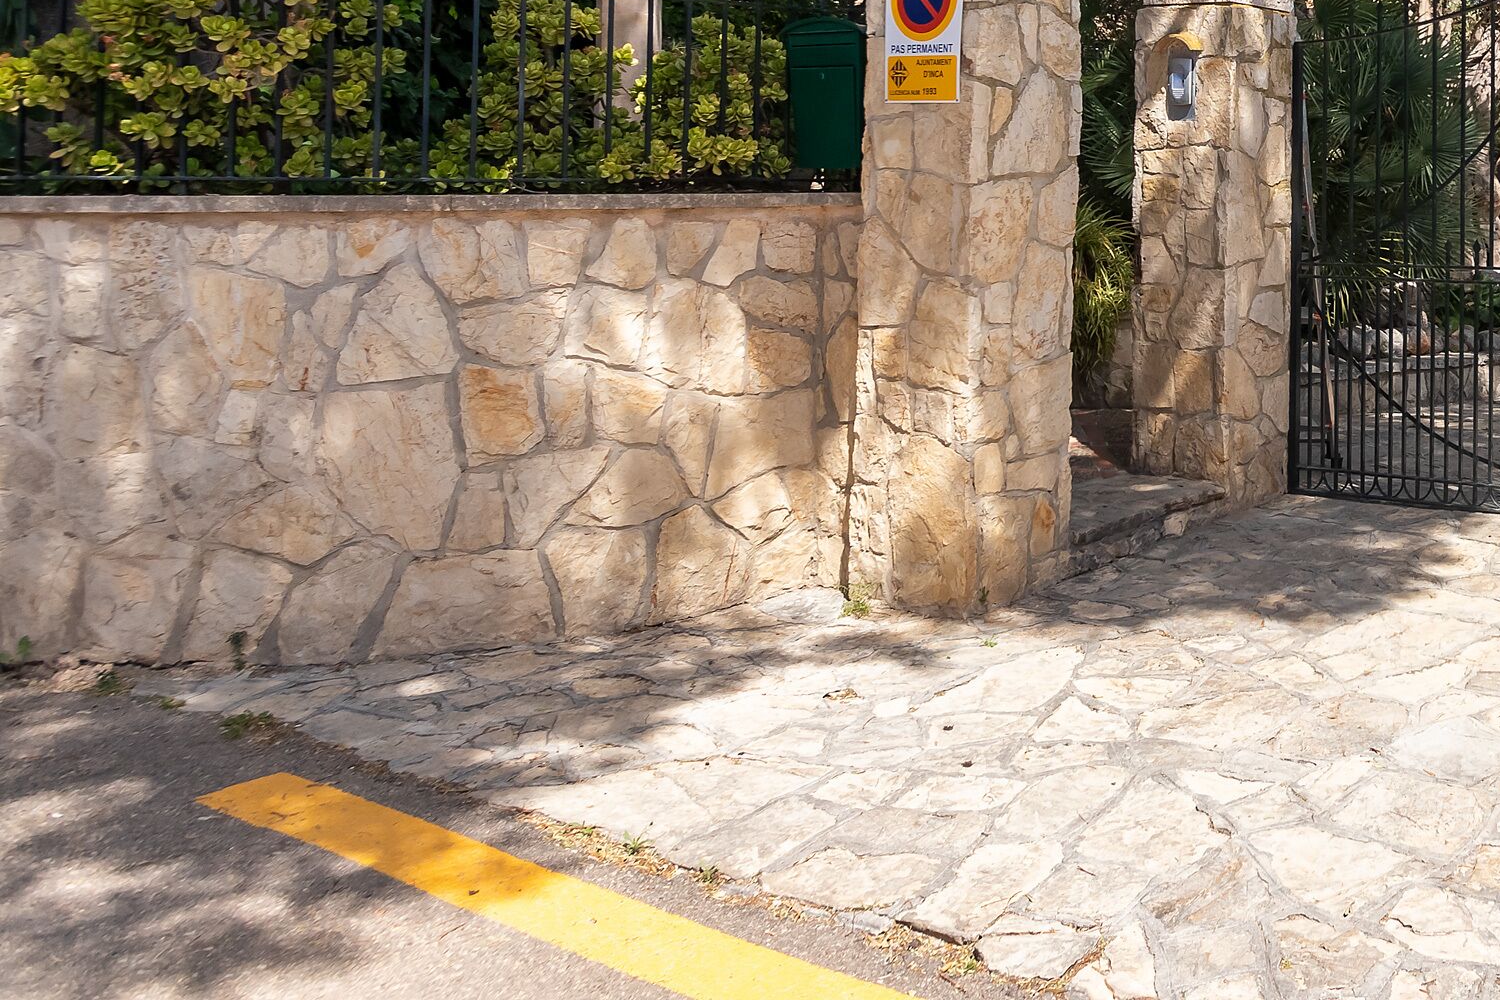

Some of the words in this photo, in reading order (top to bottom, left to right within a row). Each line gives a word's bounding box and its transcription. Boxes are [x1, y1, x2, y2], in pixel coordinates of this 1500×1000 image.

[891, 44, 905, 53] PAS
[907, 43, 953, 53] PERMANENT
[916, 58, 952, 66] AJUNTAMENT
[923, 70, 944, 78] D'INCA
[922, 87, 937, 95] 1993
